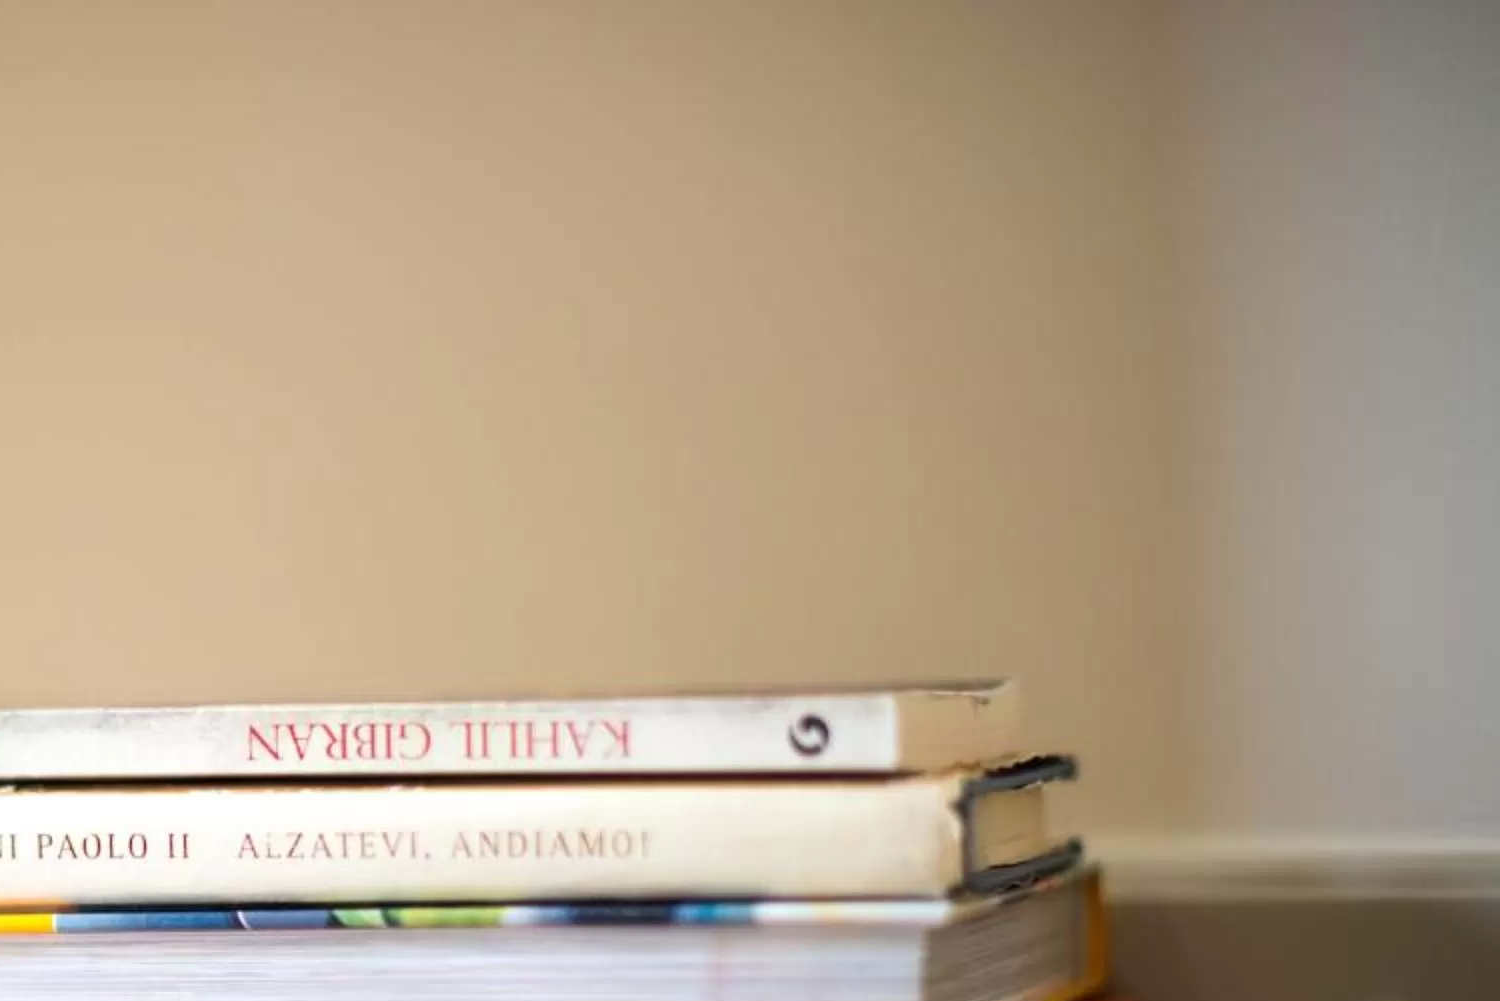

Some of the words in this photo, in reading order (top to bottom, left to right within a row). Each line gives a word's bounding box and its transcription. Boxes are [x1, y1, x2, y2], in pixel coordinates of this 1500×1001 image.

[247, 722, 431, 761] GIBRAN
[450, 720, 631, 759] KAHLIL
[37, 833, 148, 860] PAOLO
[167, 833, 190, 860] II
